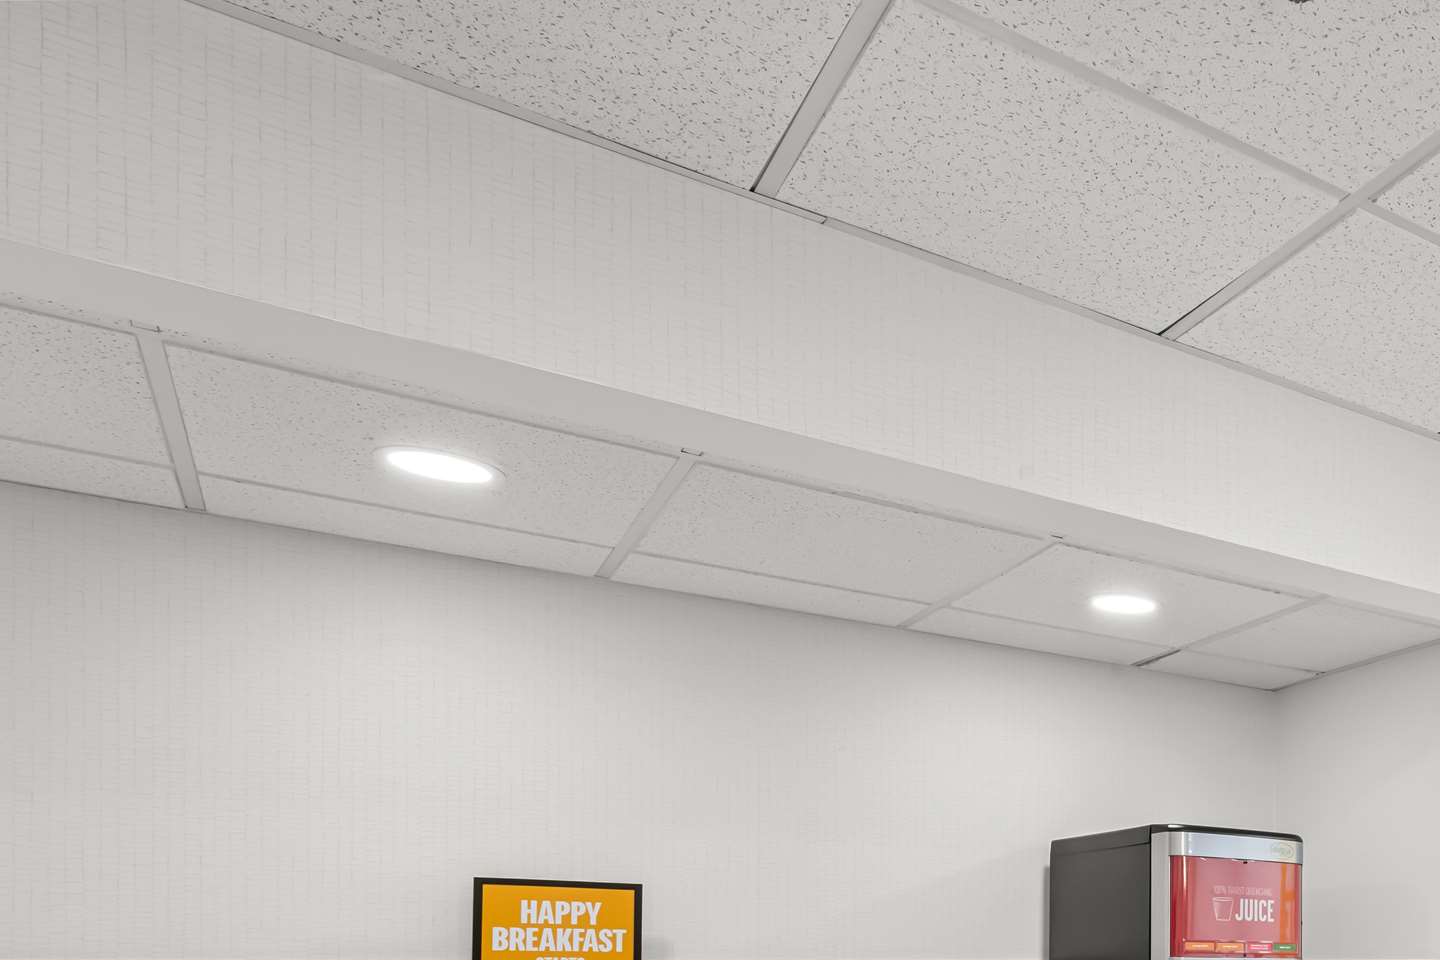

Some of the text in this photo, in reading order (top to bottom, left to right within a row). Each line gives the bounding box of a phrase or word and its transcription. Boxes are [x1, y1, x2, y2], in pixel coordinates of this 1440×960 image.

[520, 899, 602, 926] HAPPY
[1235, 898, 1275, 922] JUICE
[491, 926, 627, 953] BREAKFAST
